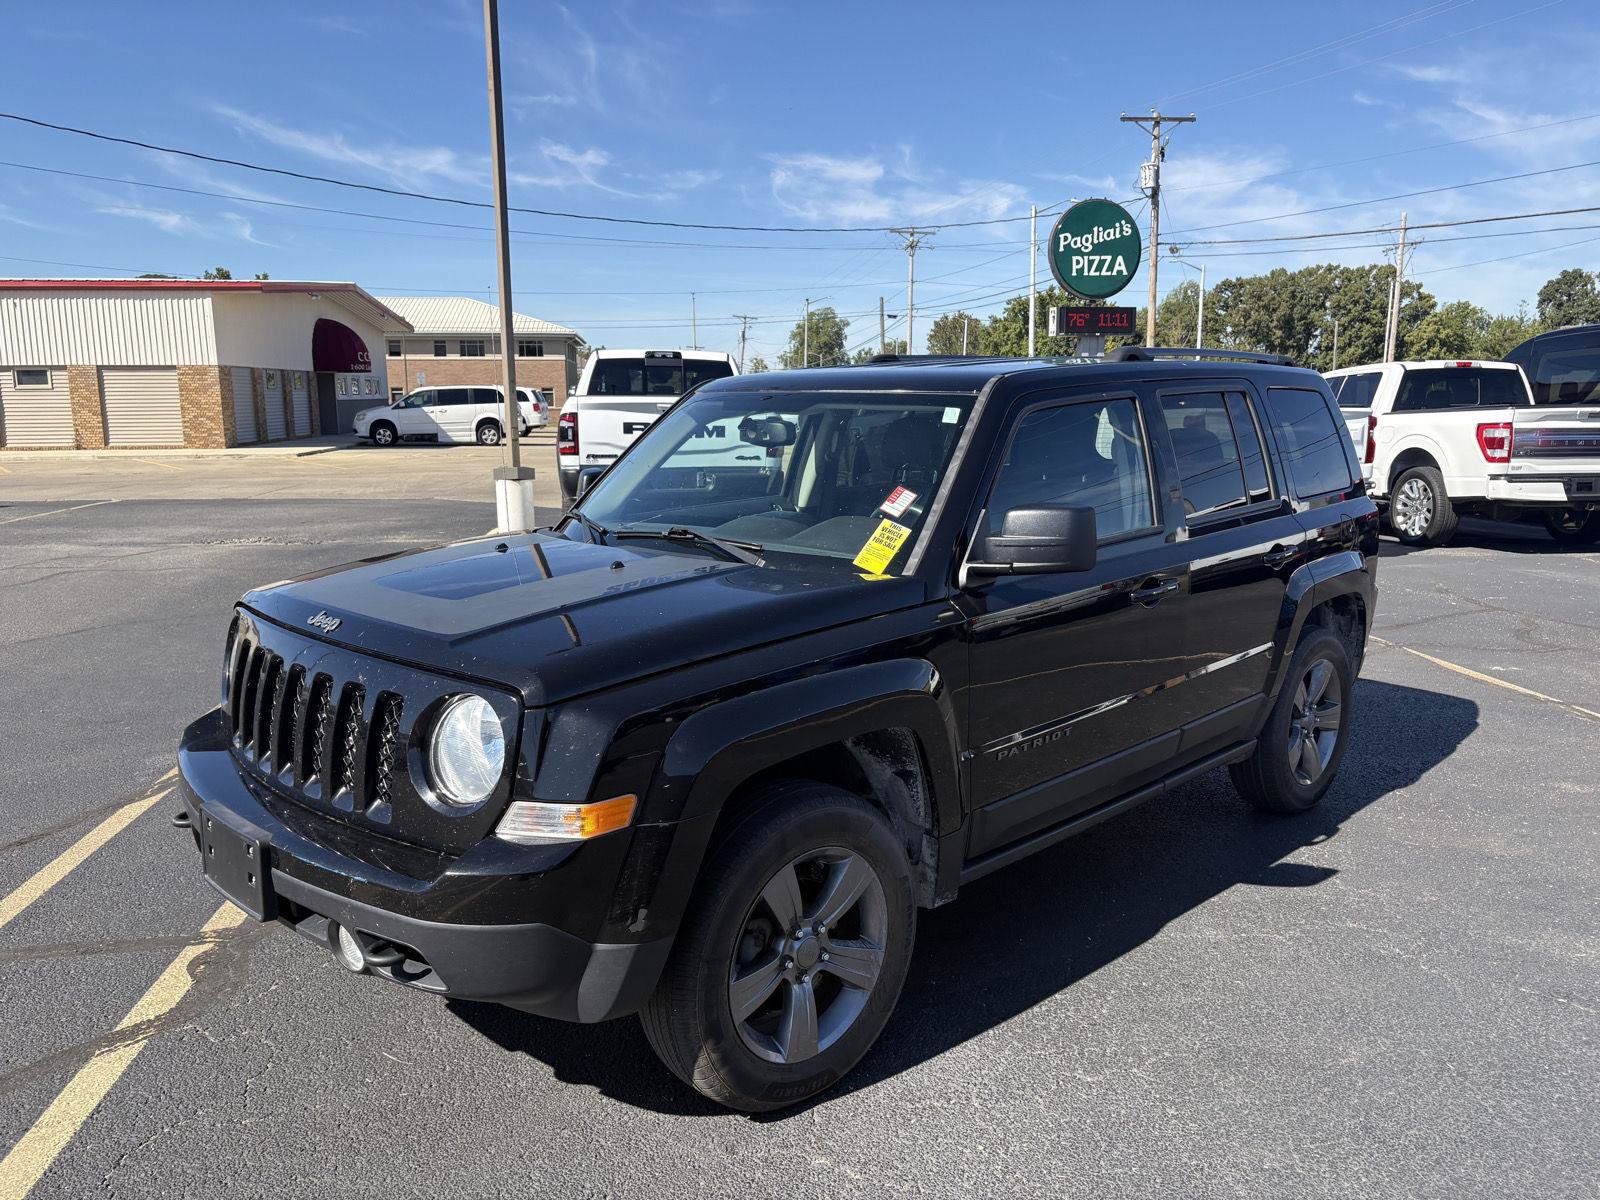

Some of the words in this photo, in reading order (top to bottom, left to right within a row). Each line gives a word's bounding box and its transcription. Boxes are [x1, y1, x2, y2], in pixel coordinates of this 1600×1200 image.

[1058, 219, 1132, 253] Pagliai's
[1071, 255, 1128, 276] PIZZA
[1098, 312, 1129, 328] 11:11
[881, 526, 903, 539] VEHICLE
[889, 522, 903, 532] THIS
[872, 536, 883, 545] FOR
[882, 540, 897, 551] SALE
[885, 535, 898, 544] NOT
[307, 610, 341, 633] Jeep
[995, 727, 1073, 761] PATRIOT
